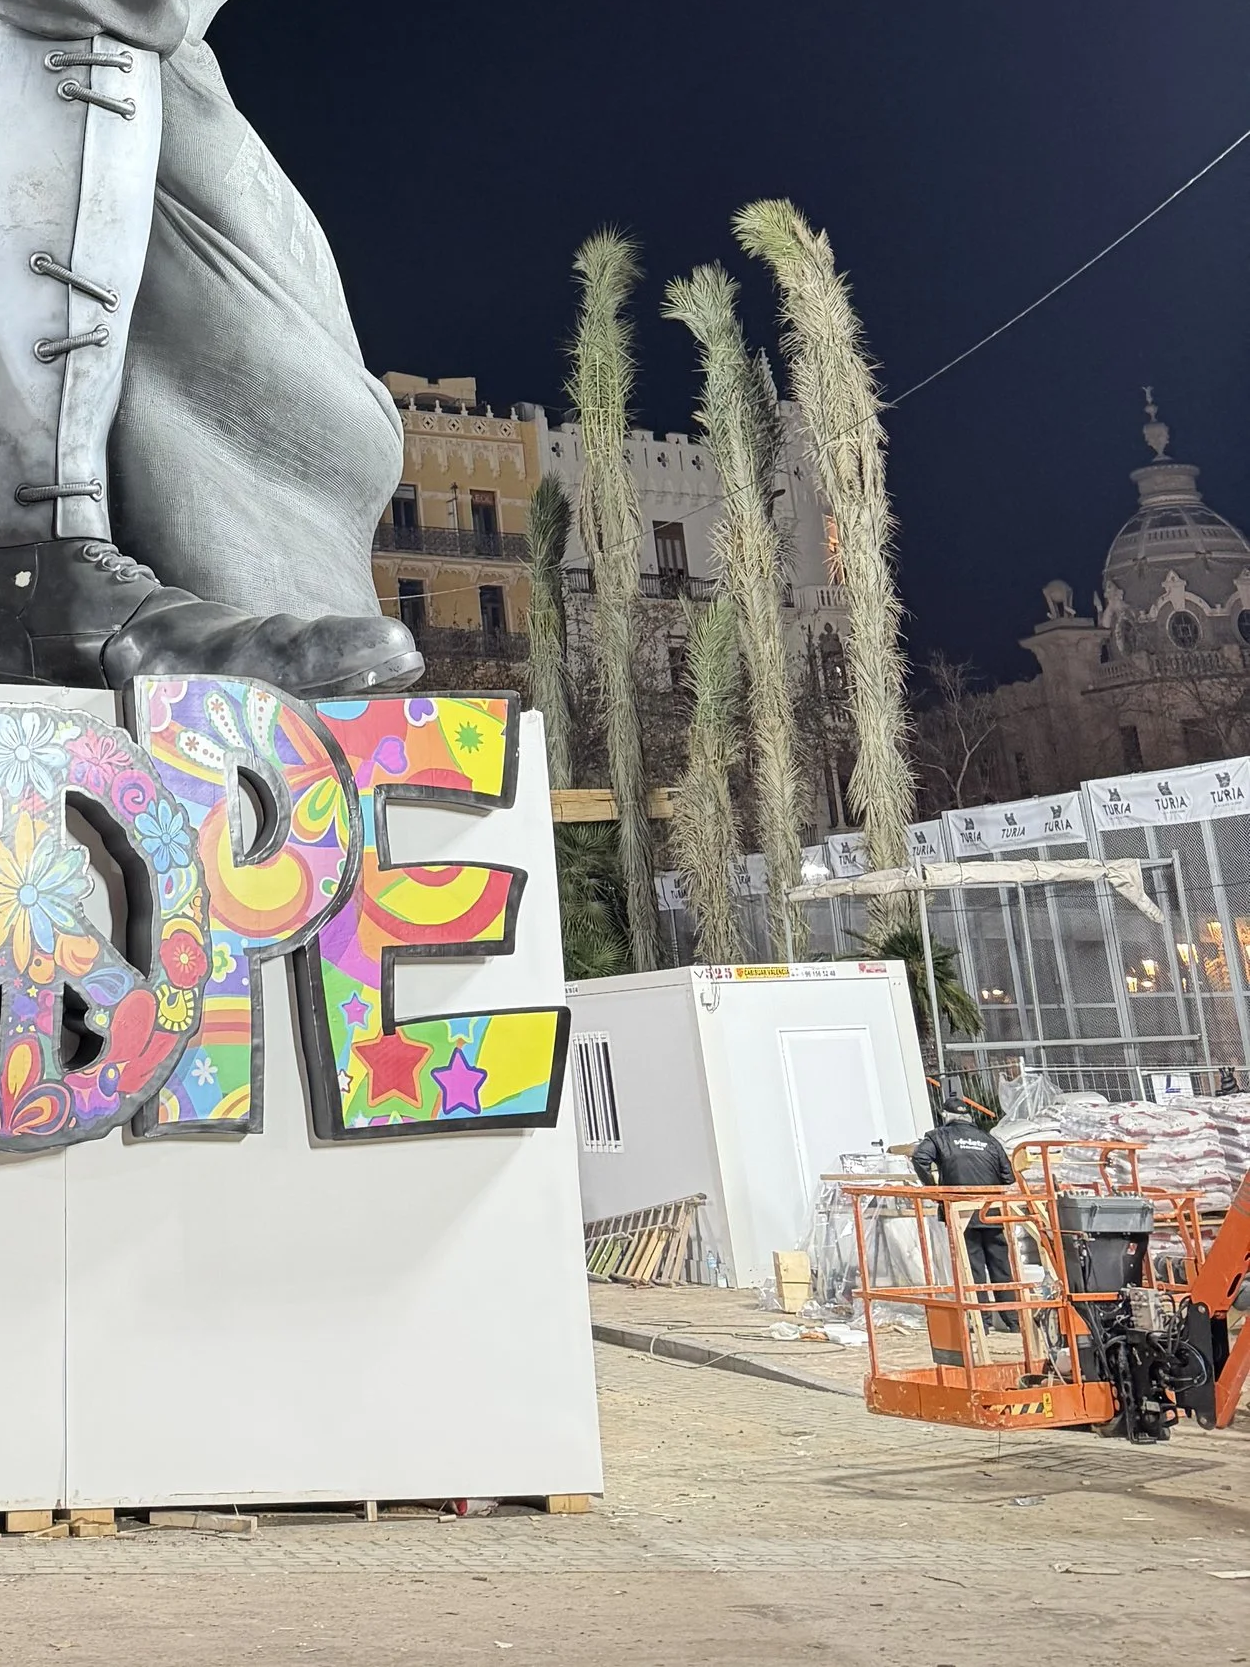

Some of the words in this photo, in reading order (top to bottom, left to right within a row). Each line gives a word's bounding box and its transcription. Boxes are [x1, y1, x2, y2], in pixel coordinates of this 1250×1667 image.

[1102, 803, 1132, 816] TURIA
[1155, 796, 1188, 811] TURIA
[1210, 787, 1244, 804] TURIA
[960, 832, 982, 844] TURIA
[1001, 826, 1026, 839] TURIA
[1044, 819, 1073, 833] TURIA
[912, 844, 936, 856] TURIA
